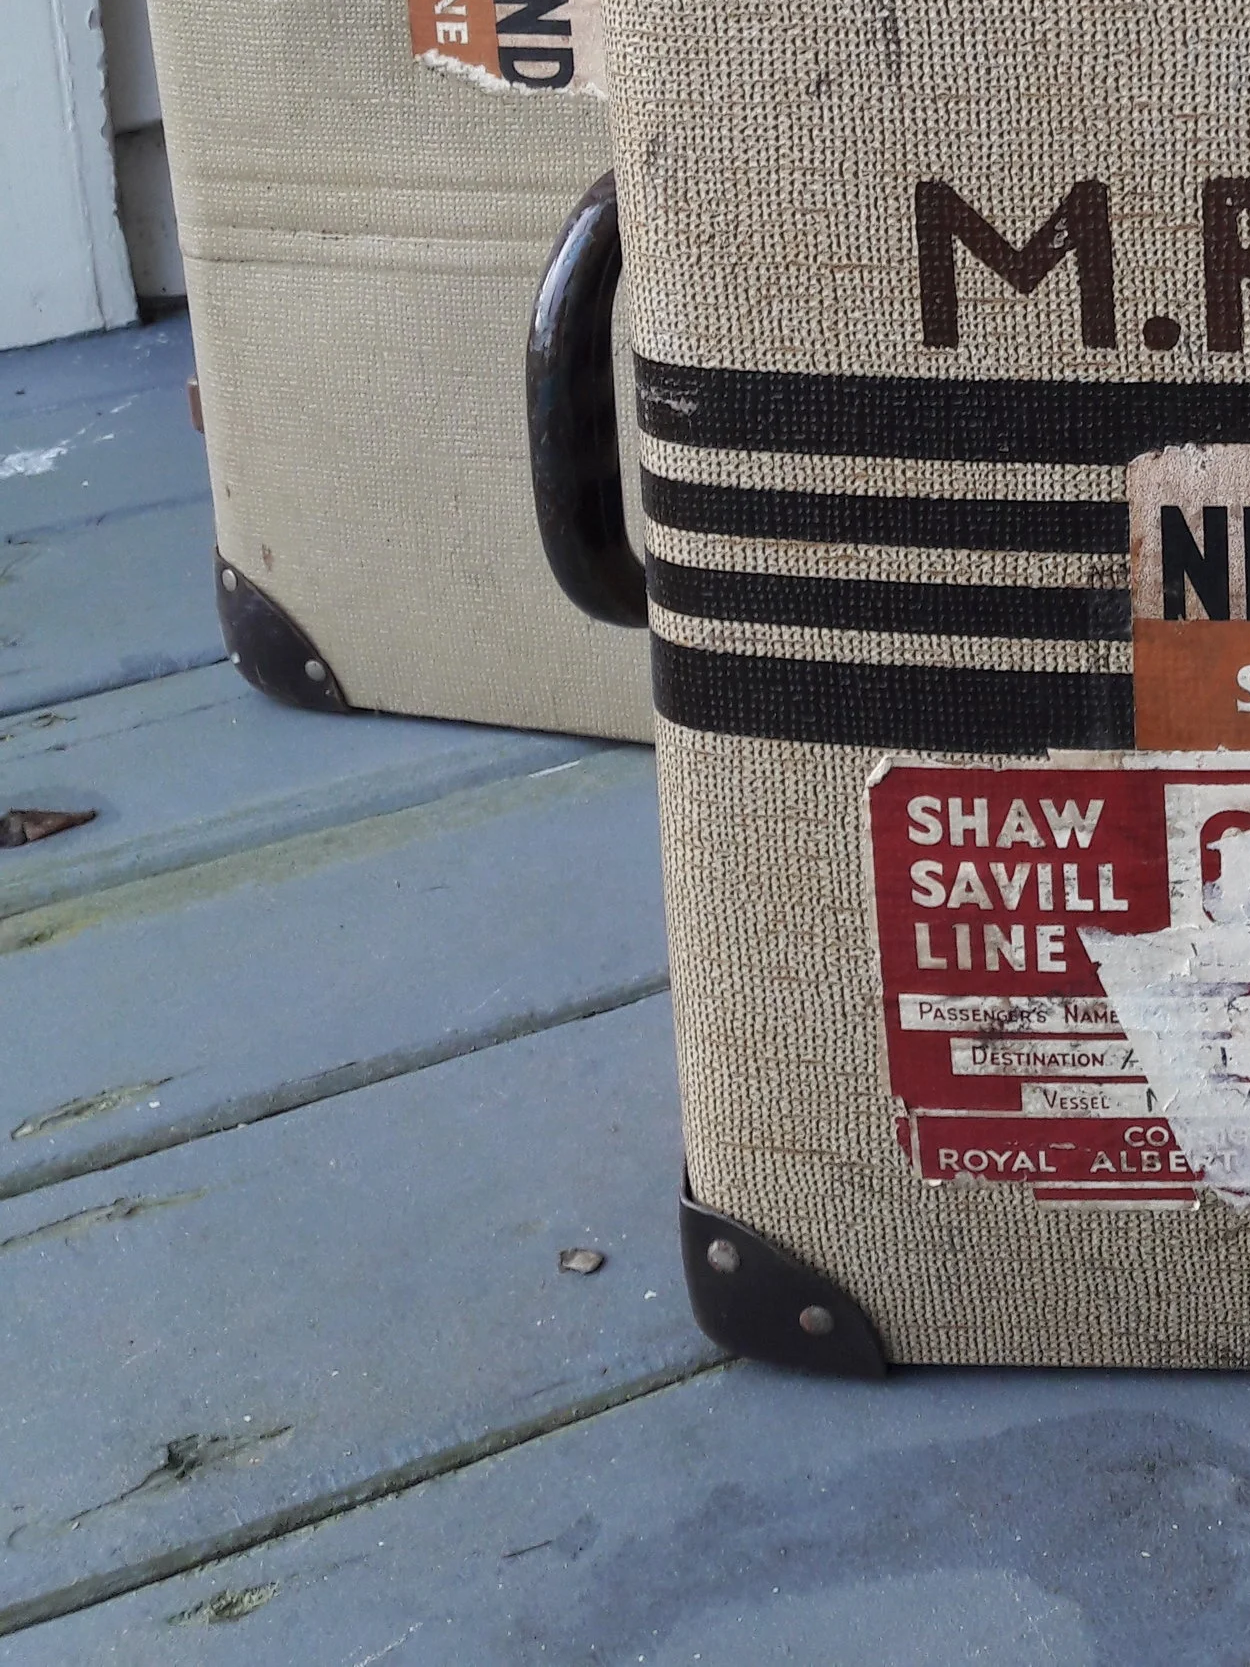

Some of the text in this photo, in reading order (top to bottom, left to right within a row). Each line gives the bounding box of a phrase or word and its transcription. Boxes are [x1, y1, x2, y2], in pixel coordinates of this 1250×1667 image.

[906, 795, 1105, 849] SHAW
[910, 859, 1129, 911] SAVILL
[914, 922, 1067, 973] LINE
[1063, 1001, 1121, 1025] NAME
[971, 1045, 1105, 1067] DESTINATION
[1043, 1091, 1110, 1110] VESSEL
[938, 1148, 1057, 1173] ROYAL
